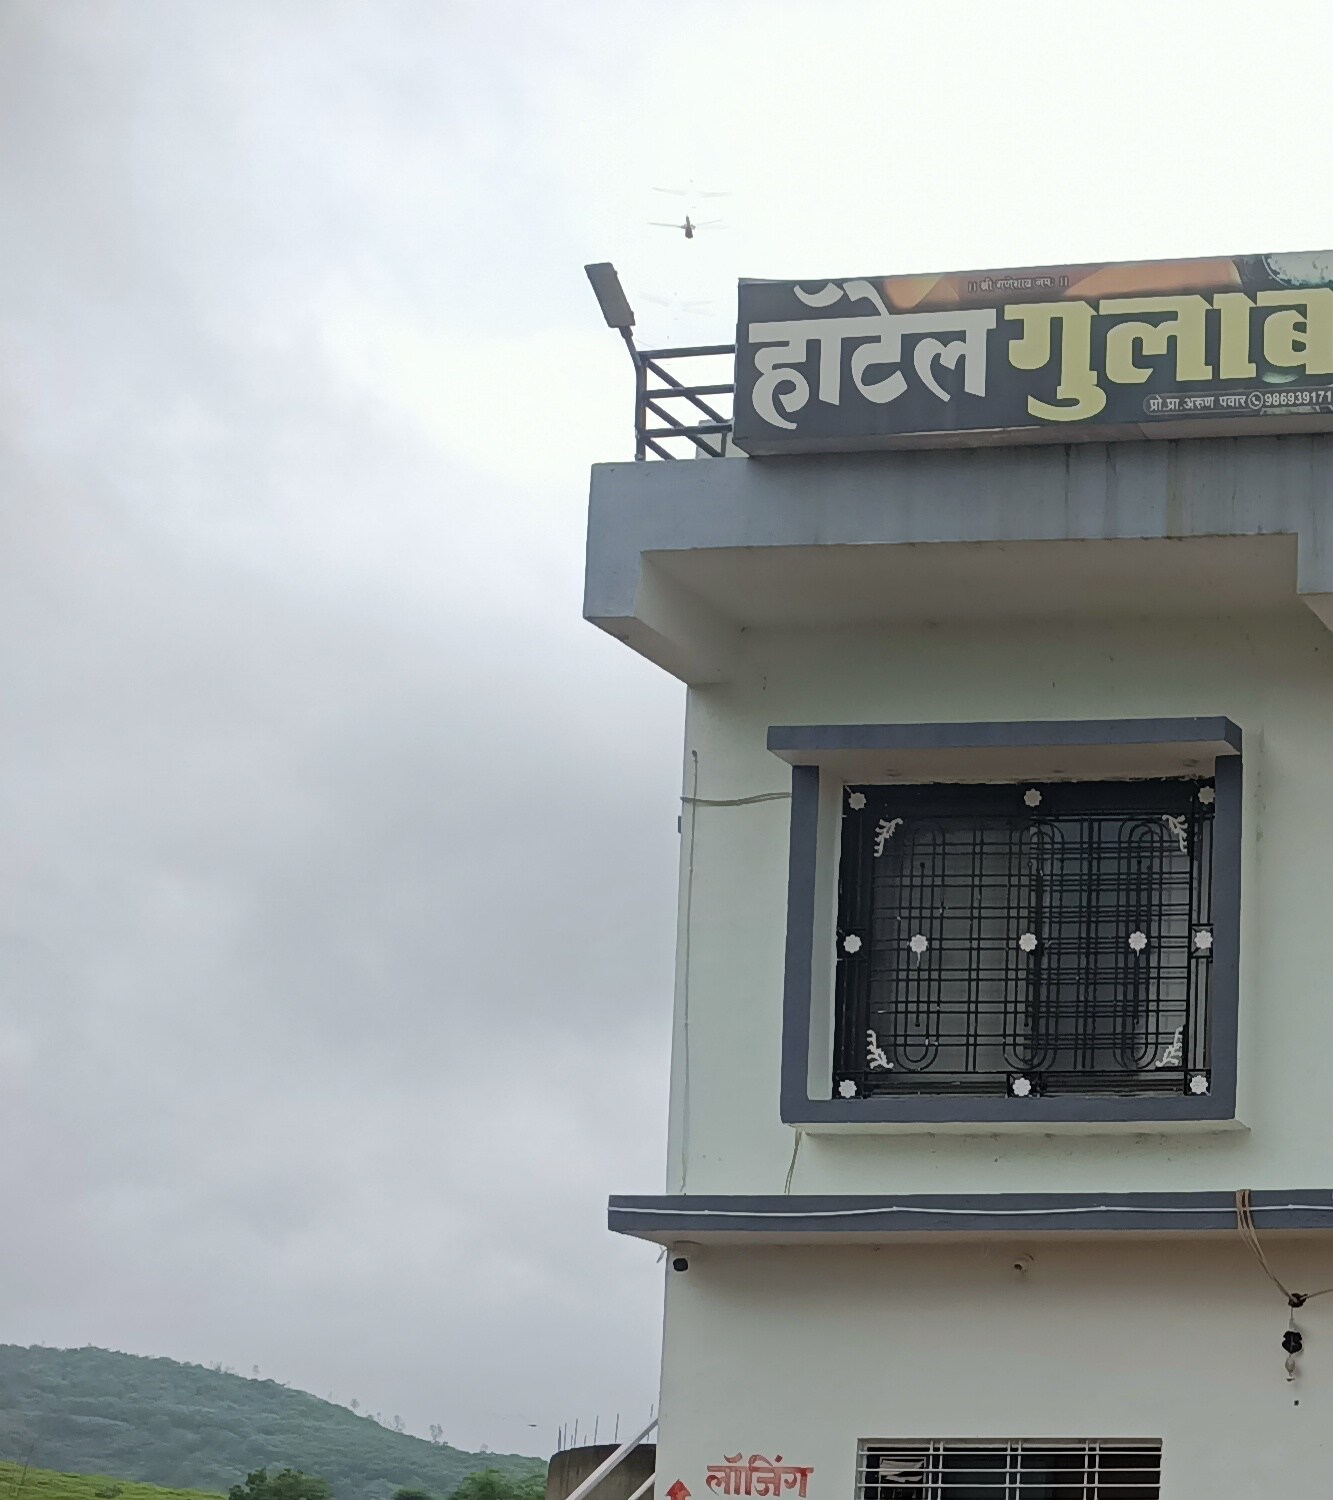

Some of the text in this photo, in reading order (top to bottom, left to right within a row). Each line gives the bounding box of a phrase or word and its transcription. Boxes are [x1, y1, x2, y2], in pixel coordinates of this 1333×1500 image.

[748, 281, 997, 430] हॉटेल
[1218, 395, 1247, 408] पवार
[705, 1452, 815, 1498] लॉजिंग
